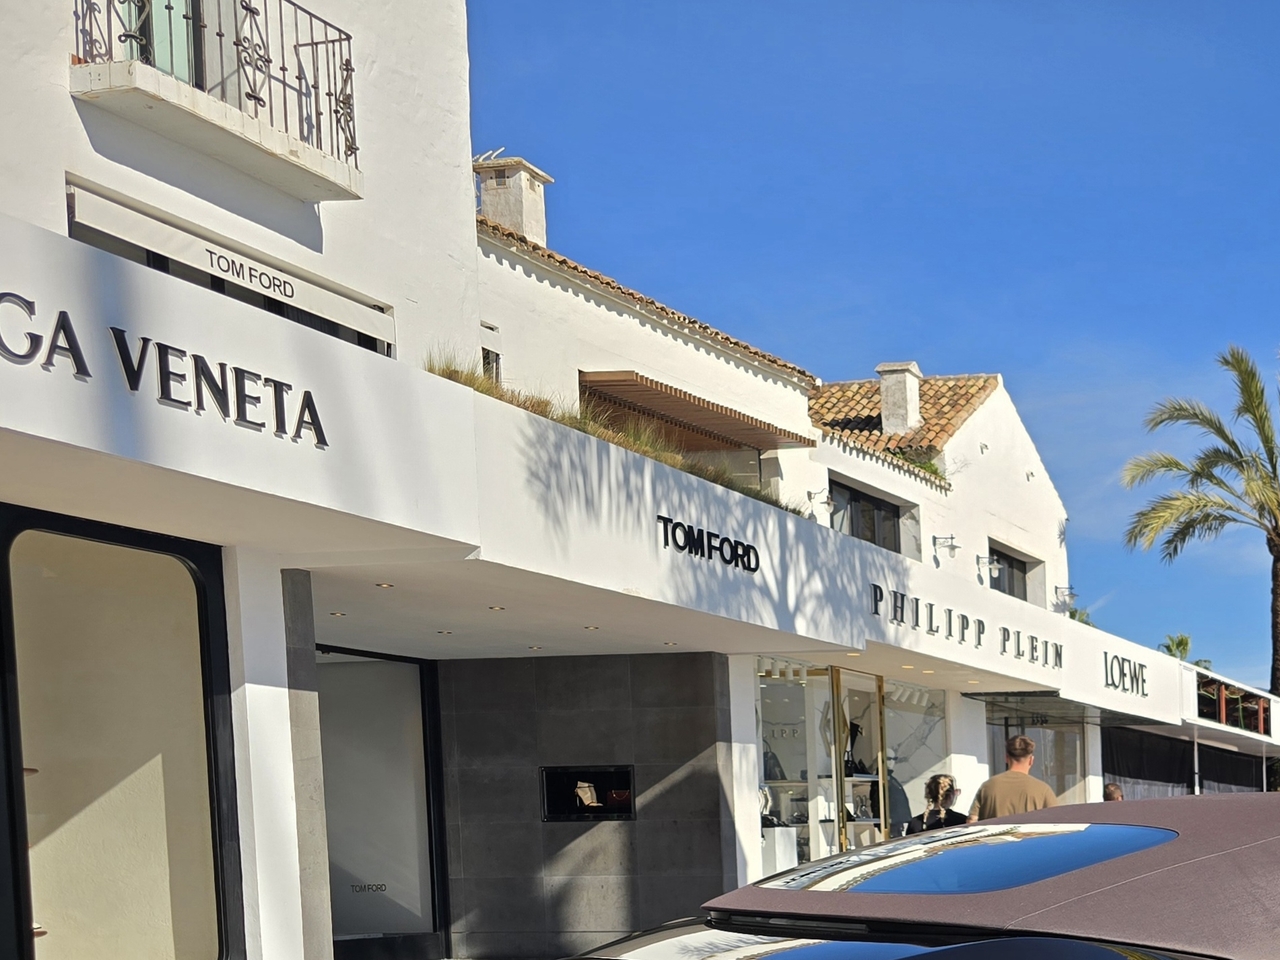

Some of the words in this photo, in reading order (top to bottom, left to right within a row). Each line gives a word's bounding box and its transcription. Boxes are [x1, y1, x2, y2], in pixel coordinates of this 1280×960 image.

[205, 248, 245, 281] TOM
[248, 266, 295, 299] FORD
[109, 326, 330, 449] VENETA
[657, 515, 705, 558] TOM
[706, 531, 760, 573] FORD
[870, 583, 986, 649] PHILIPP
[999, 626, 1063, 669] PLEIN
[1103, 651, 1148, 698] LOEWE
[350, 884, 367, 893] TOM
[367, 883, 387, 892] FORD
